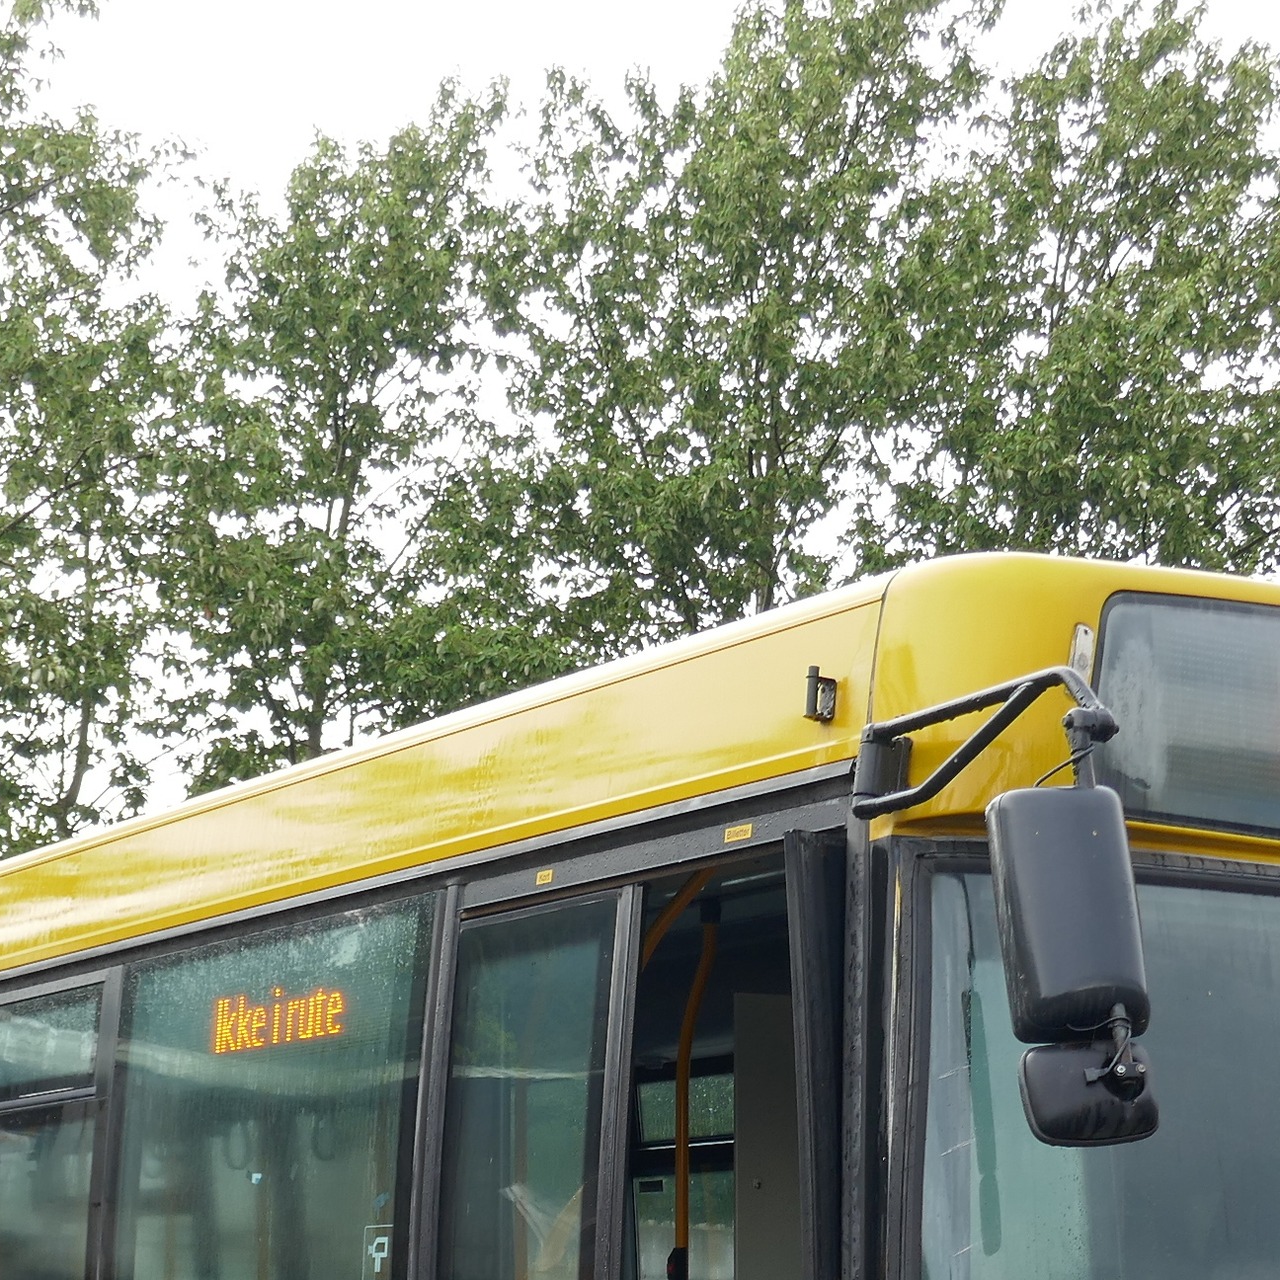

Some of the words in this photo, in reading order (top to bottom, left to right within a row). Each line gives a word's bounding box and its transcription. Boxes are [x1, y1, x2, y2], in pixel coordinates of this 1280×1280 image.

[214, 995, 267, 1054] Ikke
[271, 987, 282, 1044] i
[285, 987, 343, 1042] rute
